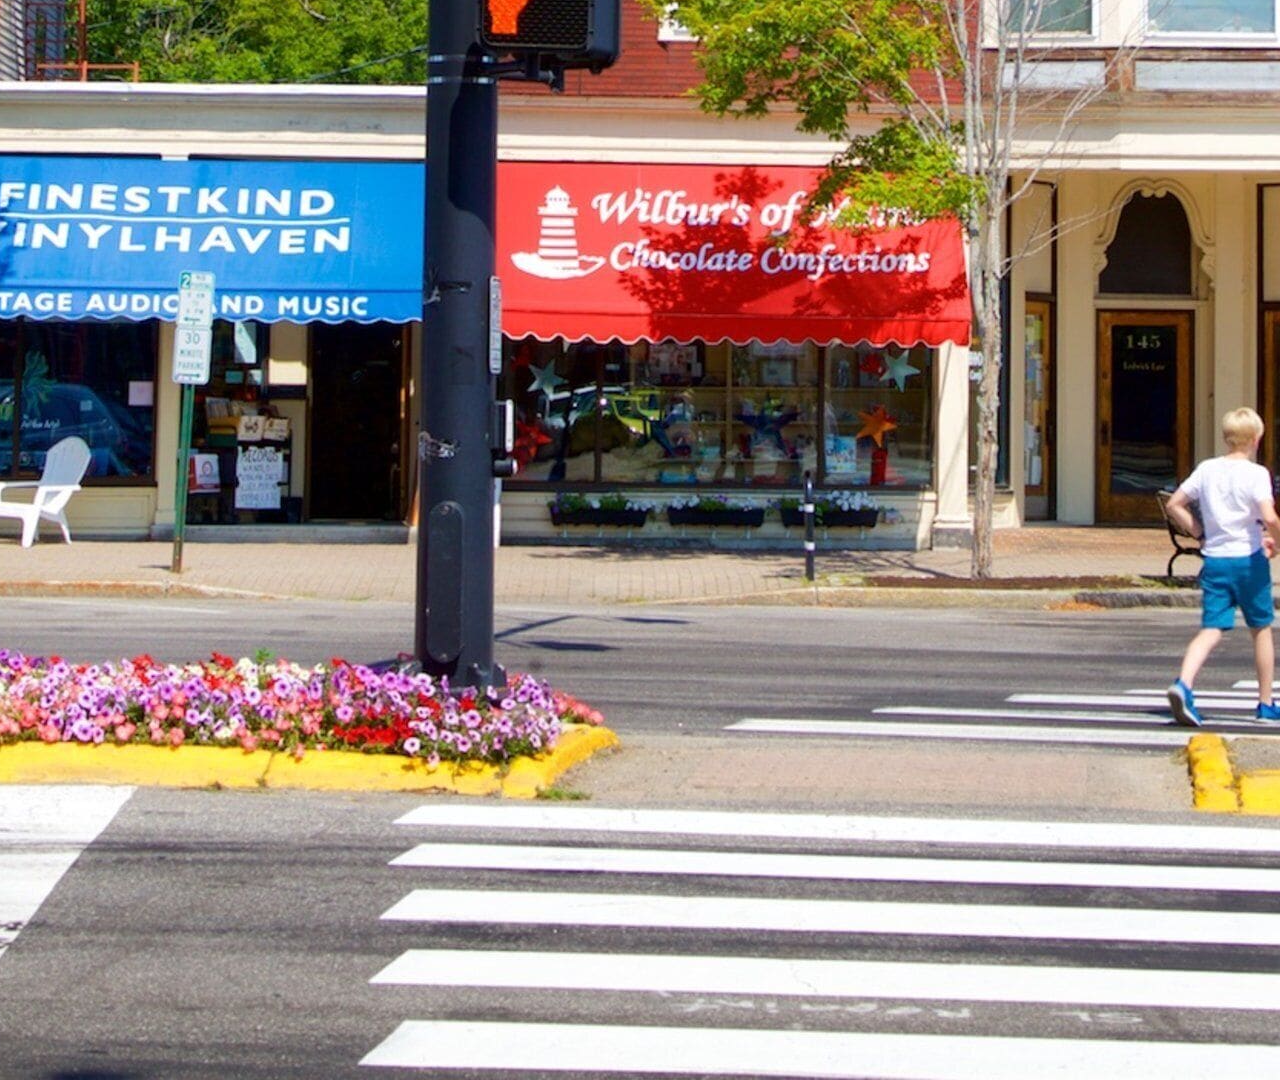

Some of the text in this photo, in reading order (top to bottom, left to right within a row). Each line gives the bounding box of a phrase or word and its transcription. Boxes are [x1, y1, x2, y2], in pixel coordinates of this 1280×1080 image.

[591, 187, 751, 227] Wilbur's
[760, 191, 807, 236] of
[609, 241, 931, 280] Chocolate Confections
[181, 273, 190, 288] 2
[86, 294, 179, 315] AUDIO
[210, 296, 263, 316] ND
[277, 297, 369, 317] MUSIC
[185, 332, 201, 344] 30
[1126, 334, 1161, 349] 145
